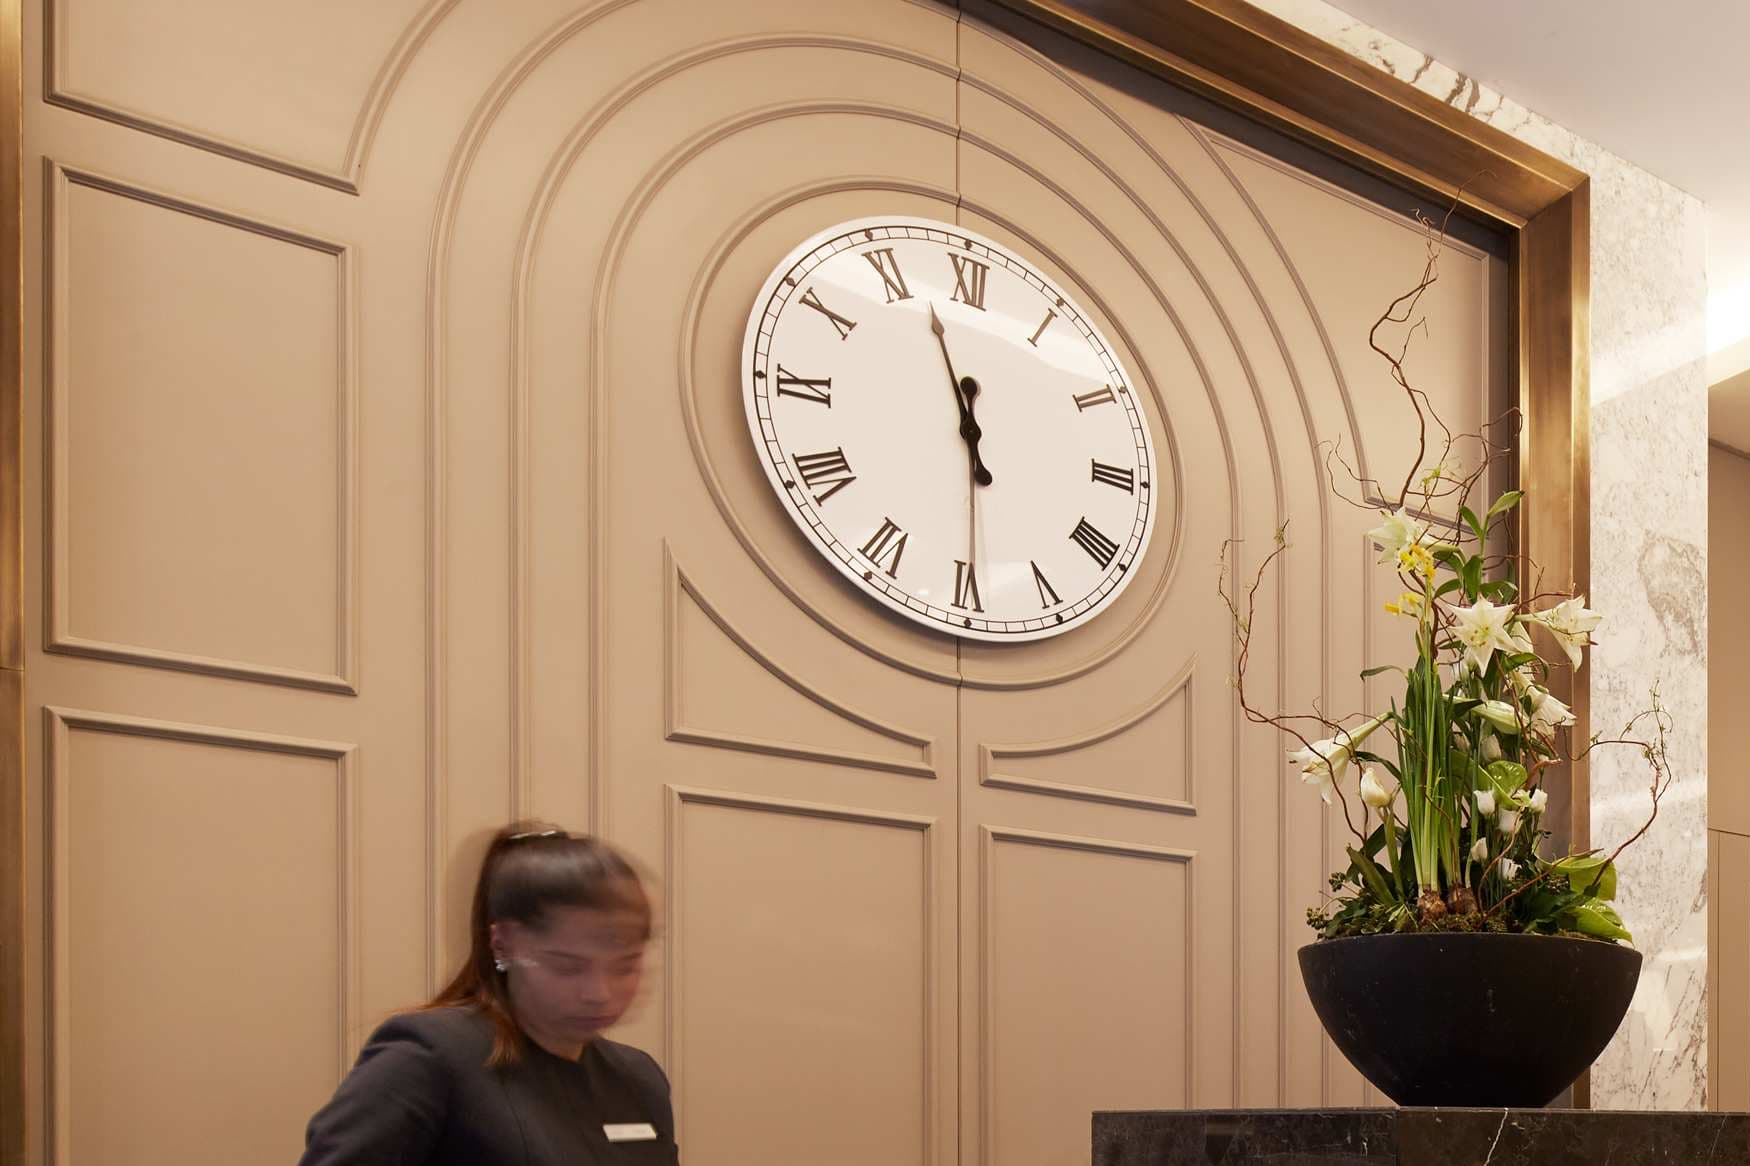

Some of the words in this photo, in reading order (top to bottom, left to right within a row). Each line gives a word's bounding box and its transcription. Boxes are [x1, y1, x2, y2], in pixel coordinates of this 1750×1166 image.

[862, 248, 914, 304] XI
[948, 253, 990, 311] XII
[799, 287, 858, 340] X
[1028, 308, 1058, 347] I
[1072, 384, 1117, 412] II
[1091, 458, 1134, 495] III
[857, 517, 909, 579] VII
[1031, 560, 1063, 609] V
